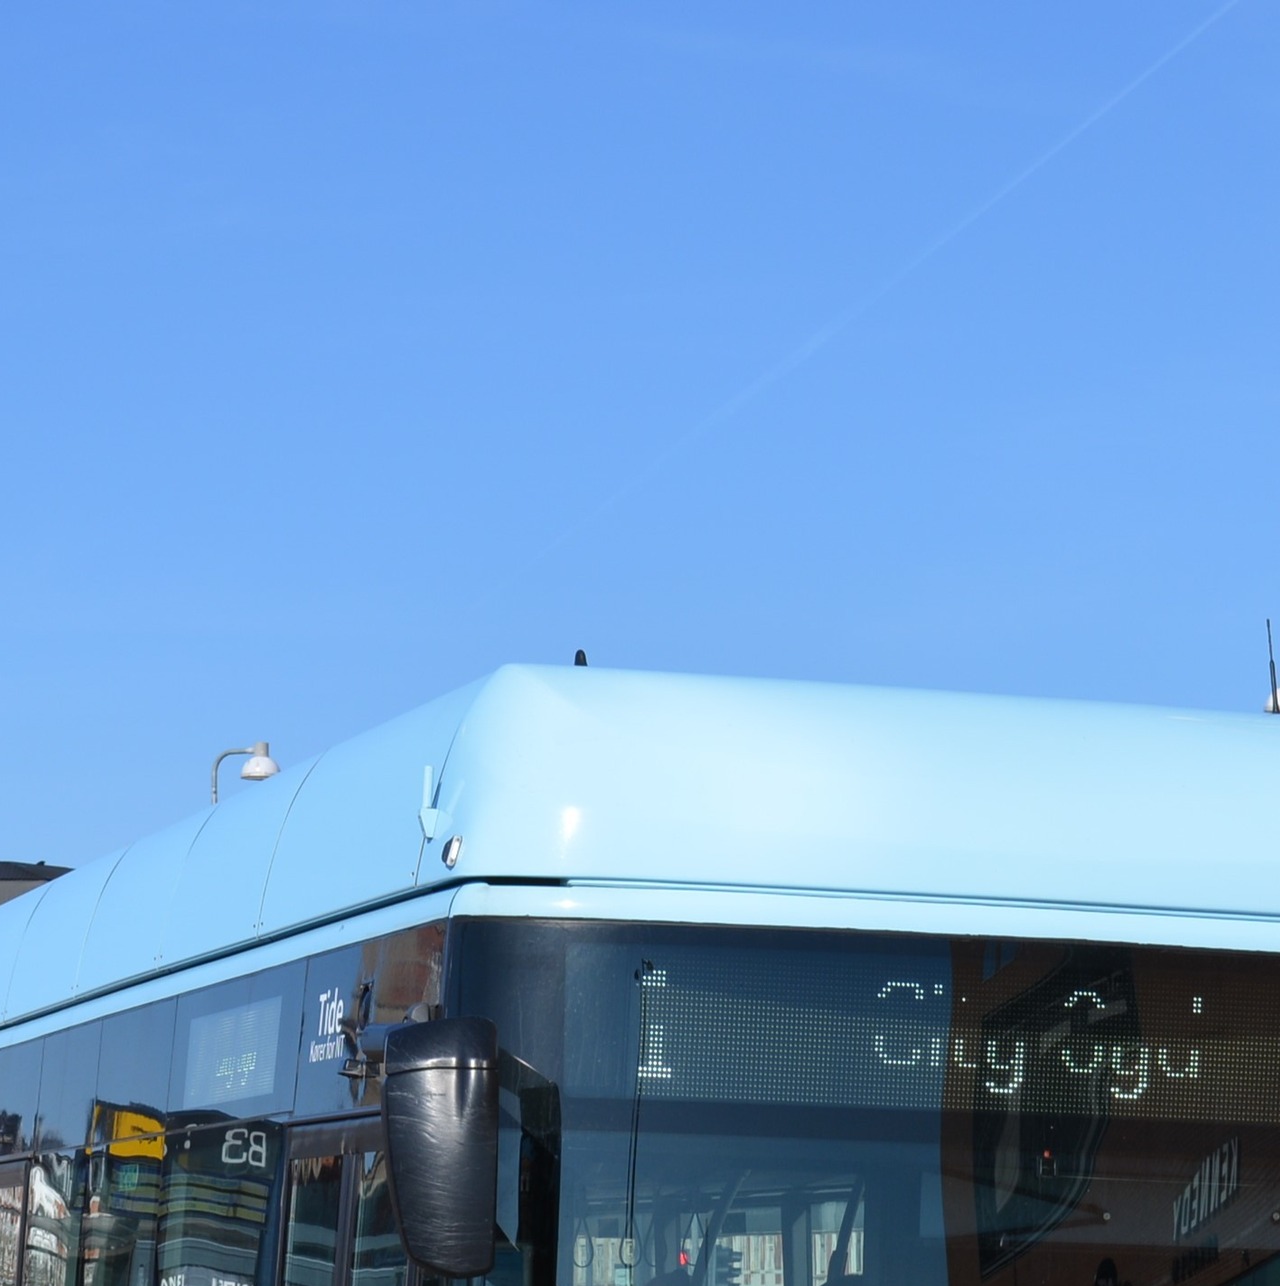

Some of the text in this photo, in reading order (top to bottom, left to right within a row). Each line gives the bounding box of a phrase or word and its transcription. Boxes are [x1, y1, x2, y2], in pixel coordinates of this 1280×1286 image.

[318, 986, 344, 1036] Tide
[638, 969, 672, 1078] 1
[335, 1034, 346, 1058] NT
